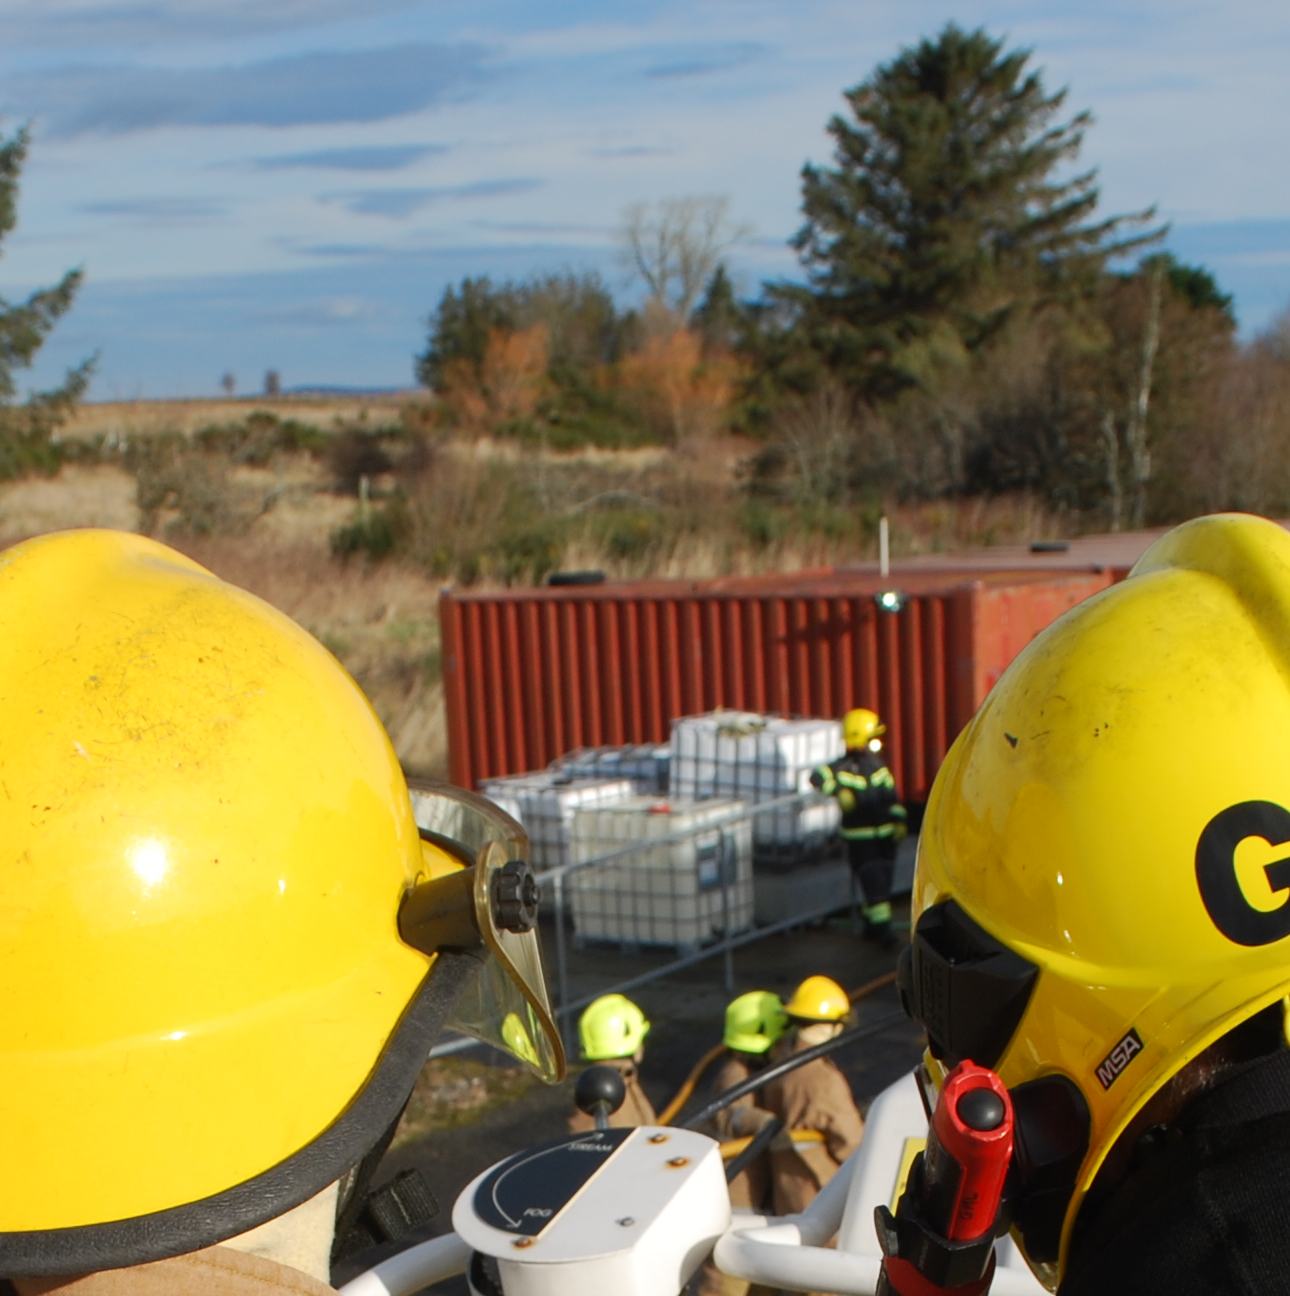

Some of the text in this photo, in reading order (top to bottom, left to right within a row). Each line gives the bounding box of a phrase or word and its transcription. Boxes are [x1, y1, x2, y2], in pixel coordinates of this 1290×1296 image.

[1097, 1034, 1141, 1087] MSA
[568, 1140, 614, 1152] STREAM
[522, 1207, 553, 1218] FOG
